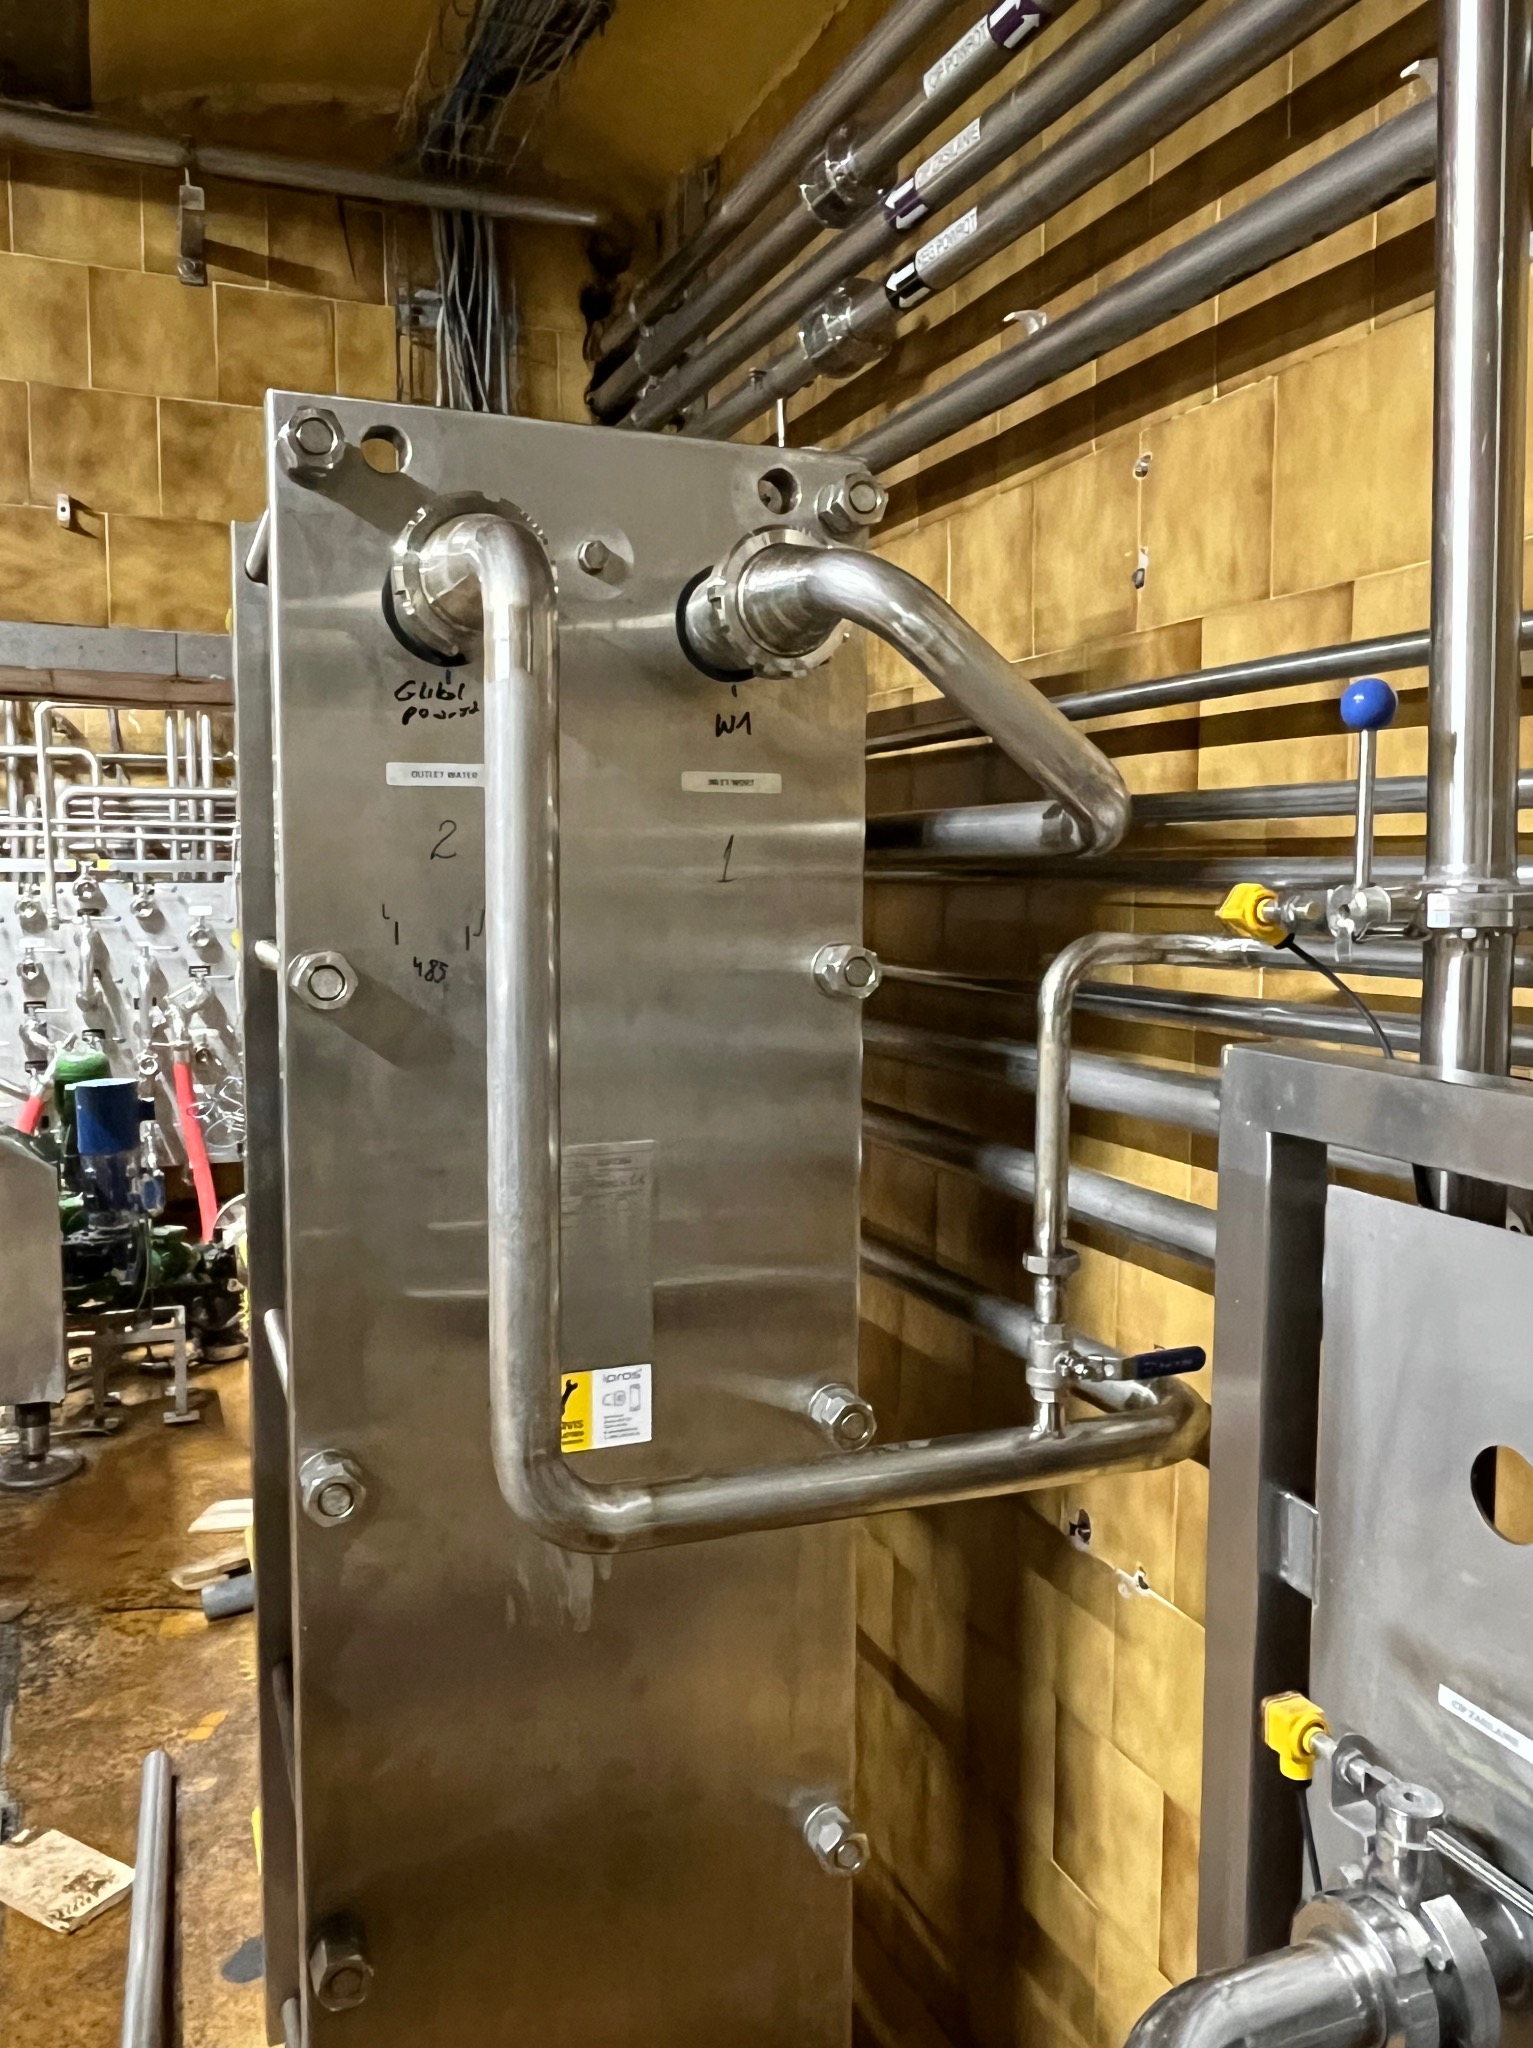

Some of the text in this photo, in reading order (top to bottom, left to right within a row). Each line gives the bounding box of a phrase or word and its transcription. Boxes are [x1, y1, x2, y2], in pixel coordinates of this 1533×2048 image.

[430, 820, 457, 860] 2
[717, 834, 736, 883] 1
[413, 956, 449, 984] 485
